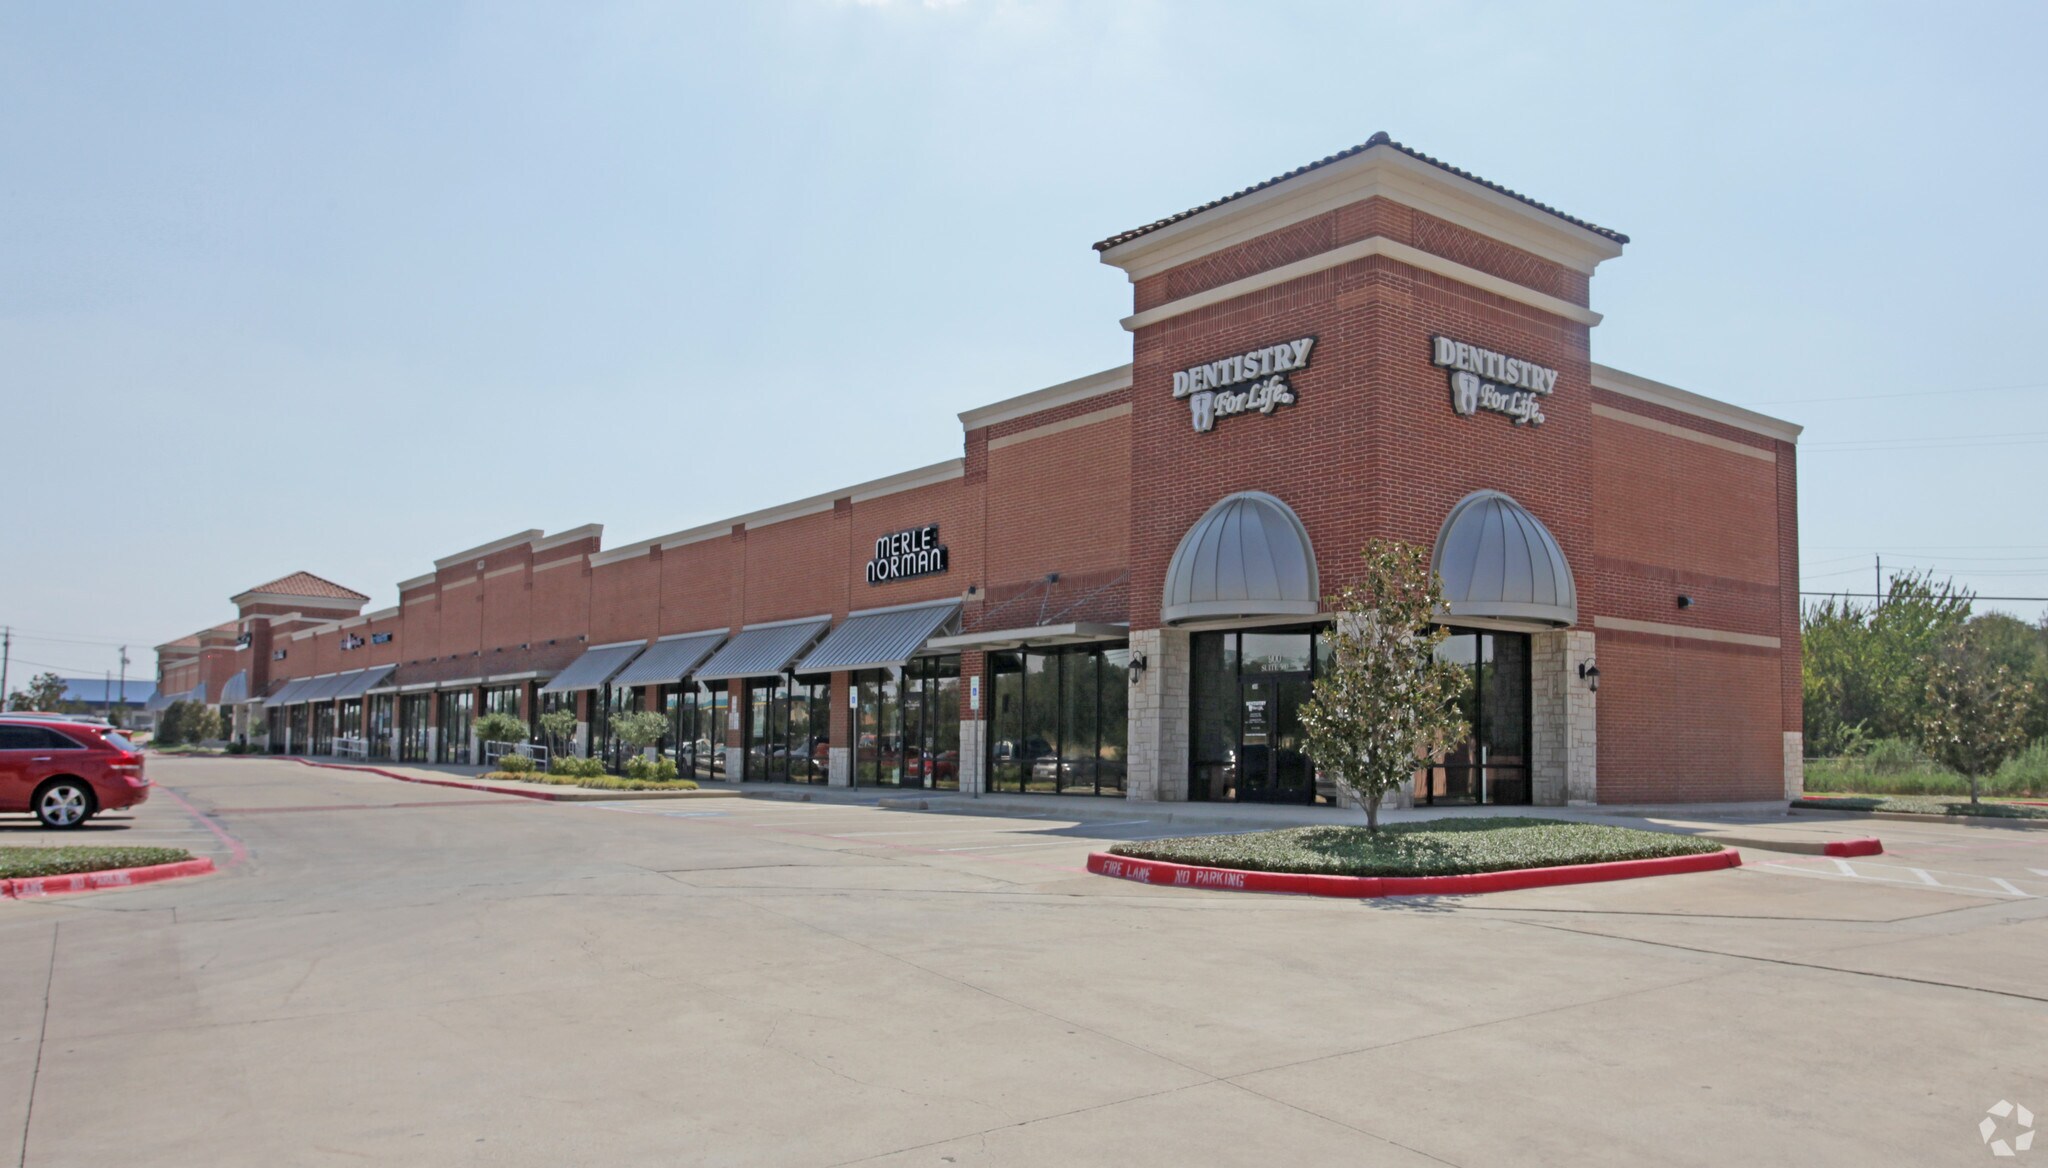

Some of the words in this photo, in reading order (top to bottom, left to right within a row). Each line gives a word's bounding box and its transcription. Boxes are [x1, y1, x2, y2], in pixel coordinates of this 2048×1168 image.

[1172, 337, 1314, 398] DENTISTRY
[1434, 336, 1559, 394] DENTISTRY
[1213, 390, 1248, 416] For
[1478, 383, 1510, 412] For
[875, 527, 931, 560] MERLE
[866, 548, 941, 582] NORMAN
[1103, 860, 1122, 876] FIRE
[1126, 864, 1152, 884] LANE
[1174, 869, 1190, 884] NO
[1195, 870, 1247, 888] PARKING
